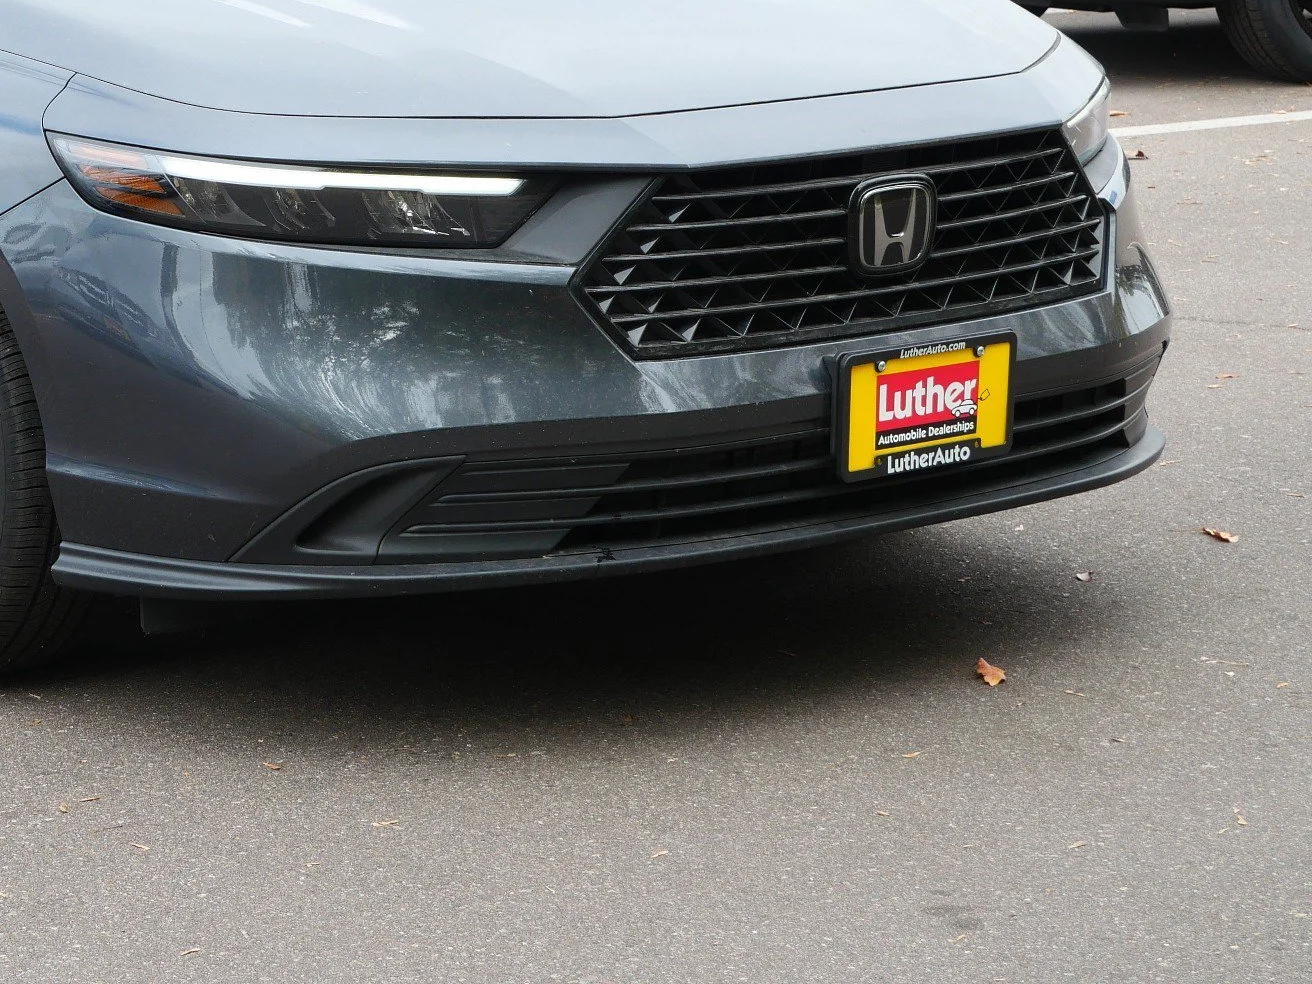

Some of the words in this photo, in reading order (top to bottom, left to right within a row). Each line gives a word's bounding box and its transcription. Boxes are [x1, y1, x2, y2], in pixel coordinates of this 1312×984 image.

[900, 341, 966, 359] LutherAuto.com
[878, 376, 978, 422] Luther
[878, 429, 927, 446] Automobile
[928, 420, 975, 437] Dealerships
[887, 444, 971, 474] LutherAuto
